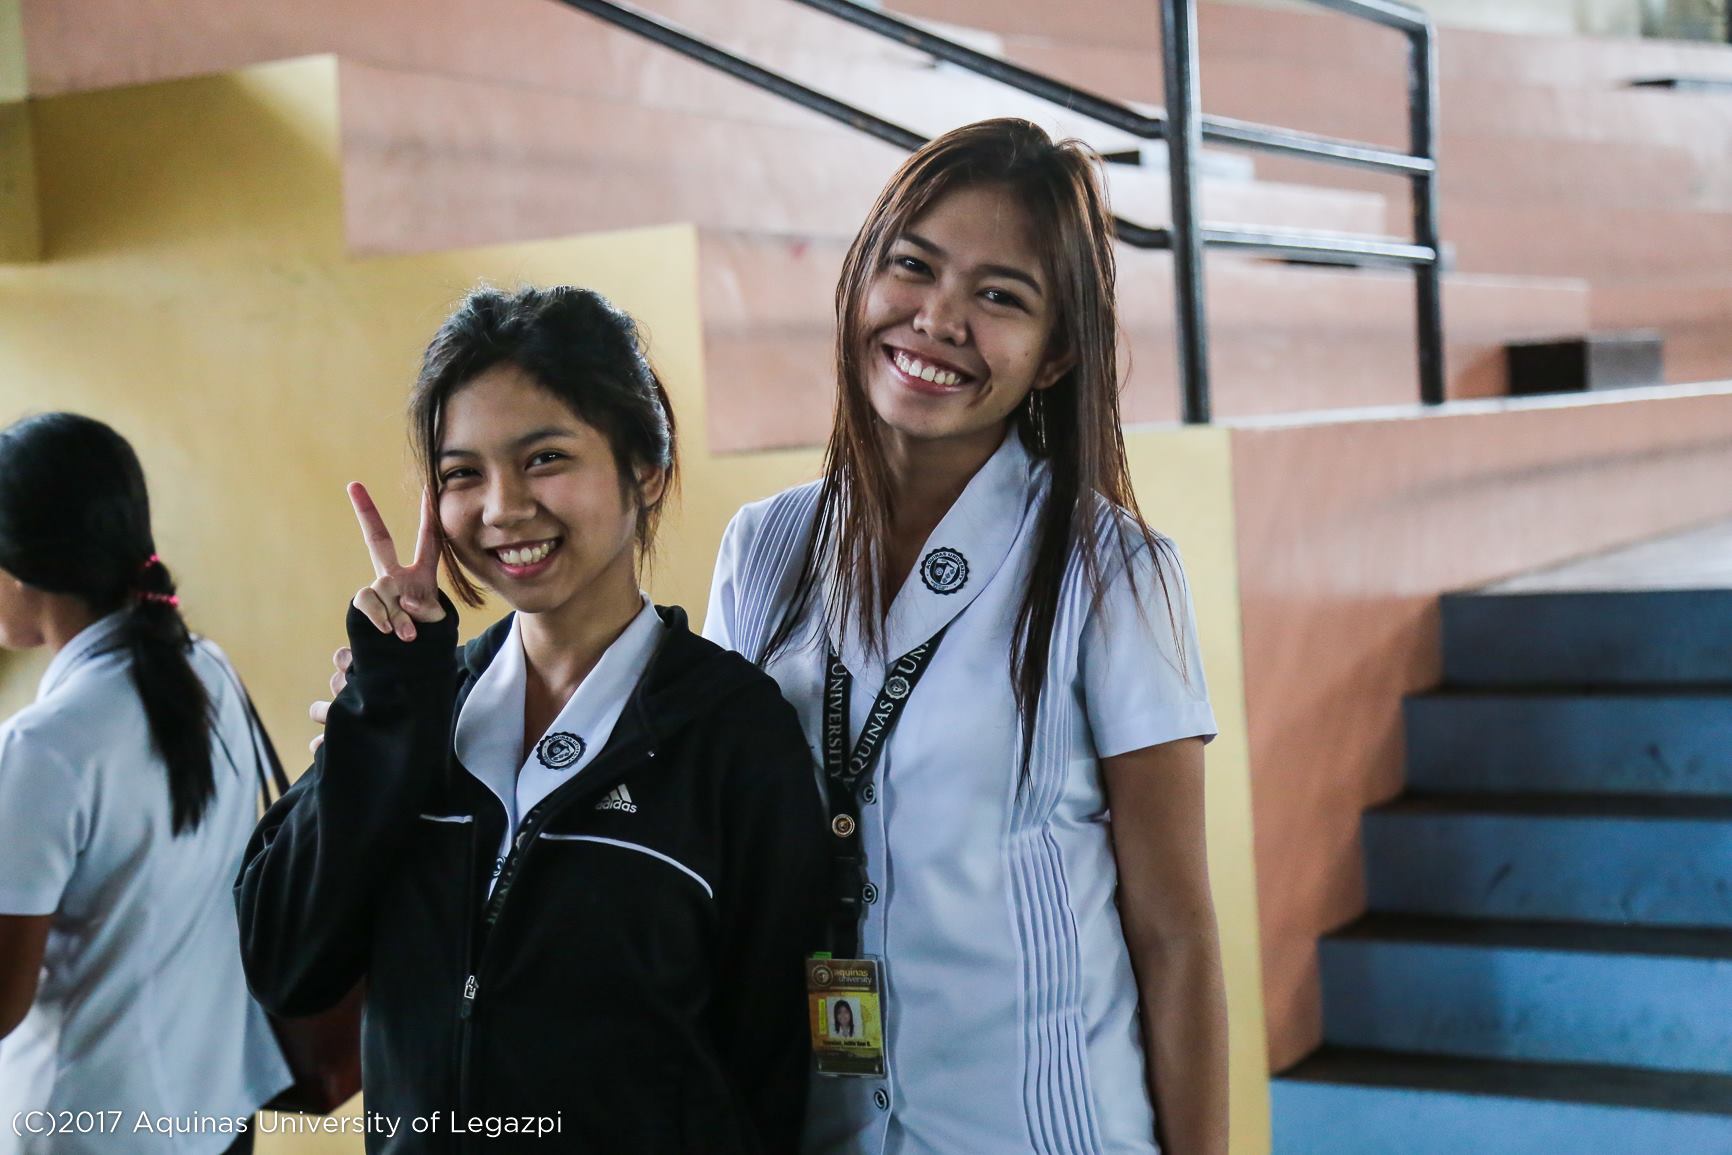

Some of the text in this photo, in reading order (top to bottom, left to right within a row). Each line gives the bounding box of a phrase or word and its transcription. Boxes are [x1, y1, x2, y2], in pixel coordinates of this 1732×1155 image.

[926, 551, 947, 569] AQUINAS
[897, 642, 930, 675] UN
[828, 662, 848, 778] UNIVERSITY
[595, 799, 638, 813] adidas
